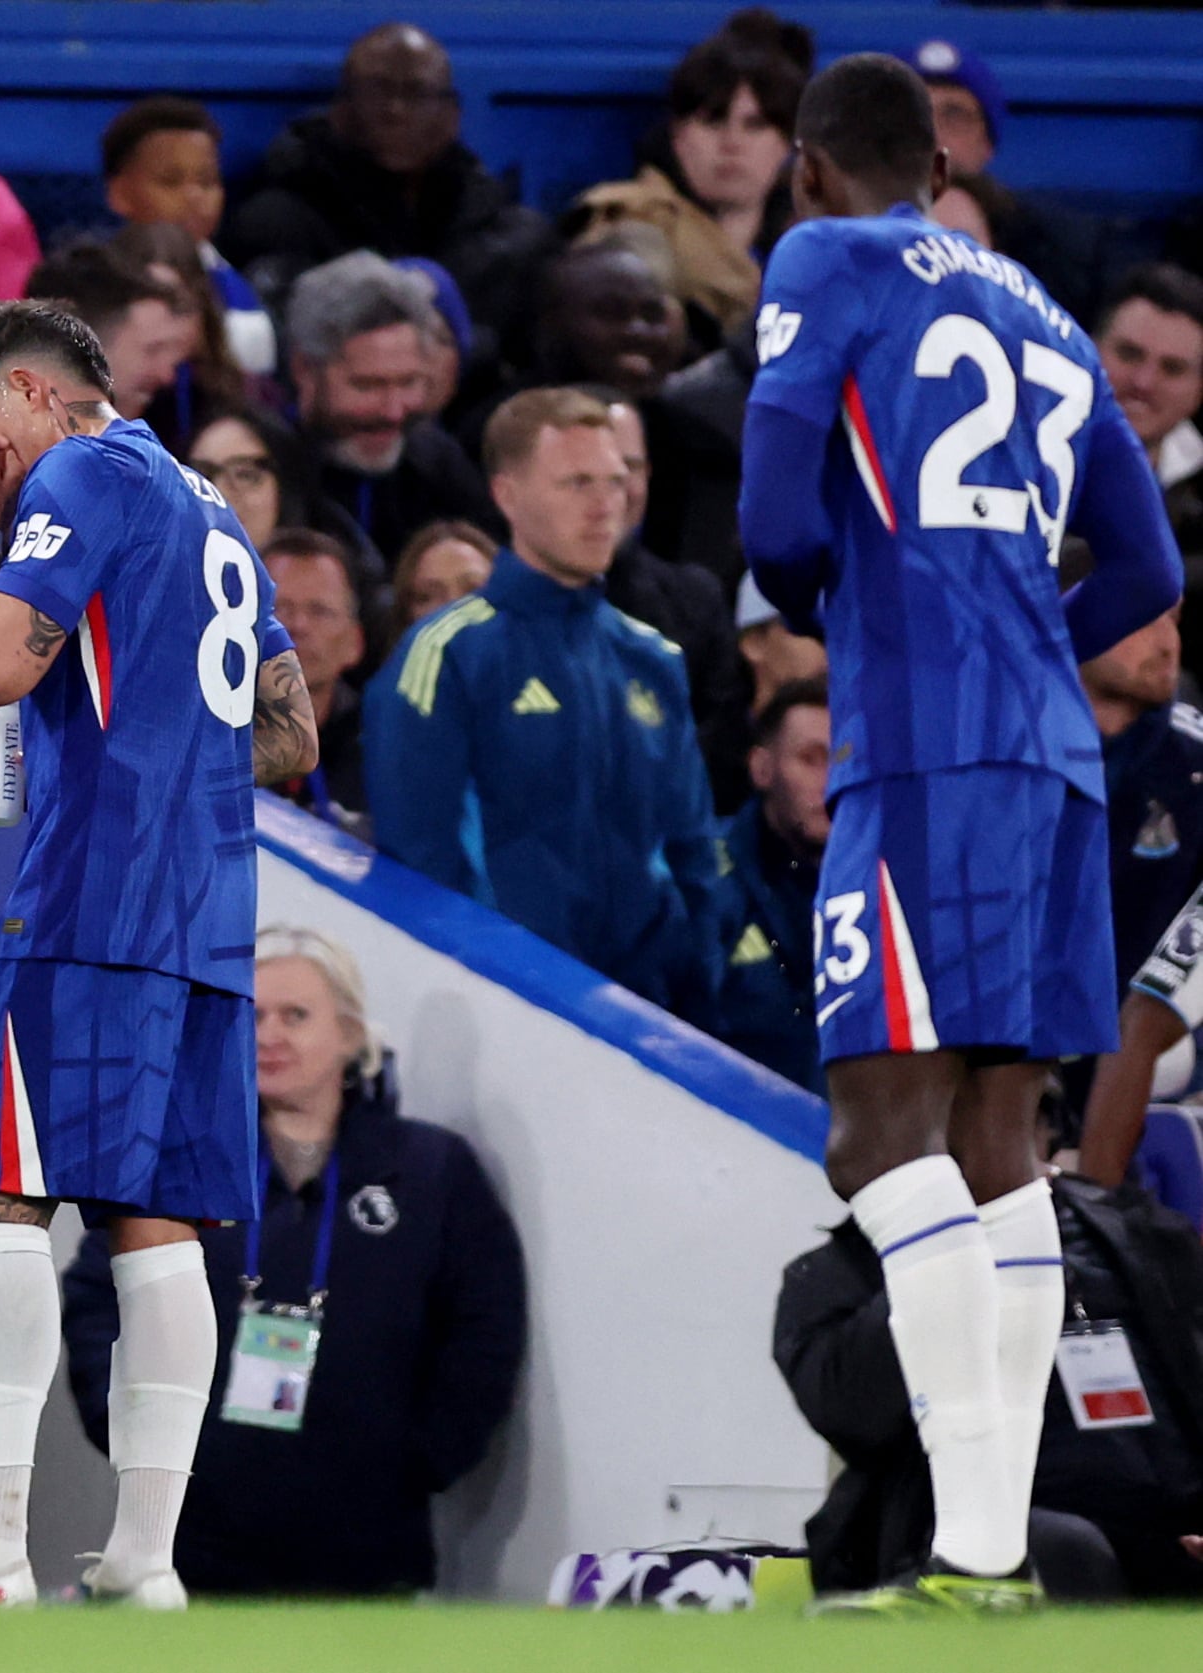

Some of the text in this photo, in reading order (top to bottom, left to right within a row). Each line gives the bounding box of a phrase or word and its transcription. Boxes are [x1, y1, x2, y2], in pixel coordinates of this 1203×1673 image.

[915, 314, 1094, 567] 23
[197, 528, 259, 729] 8
[2, 722, 19, 801] HYDRATE
